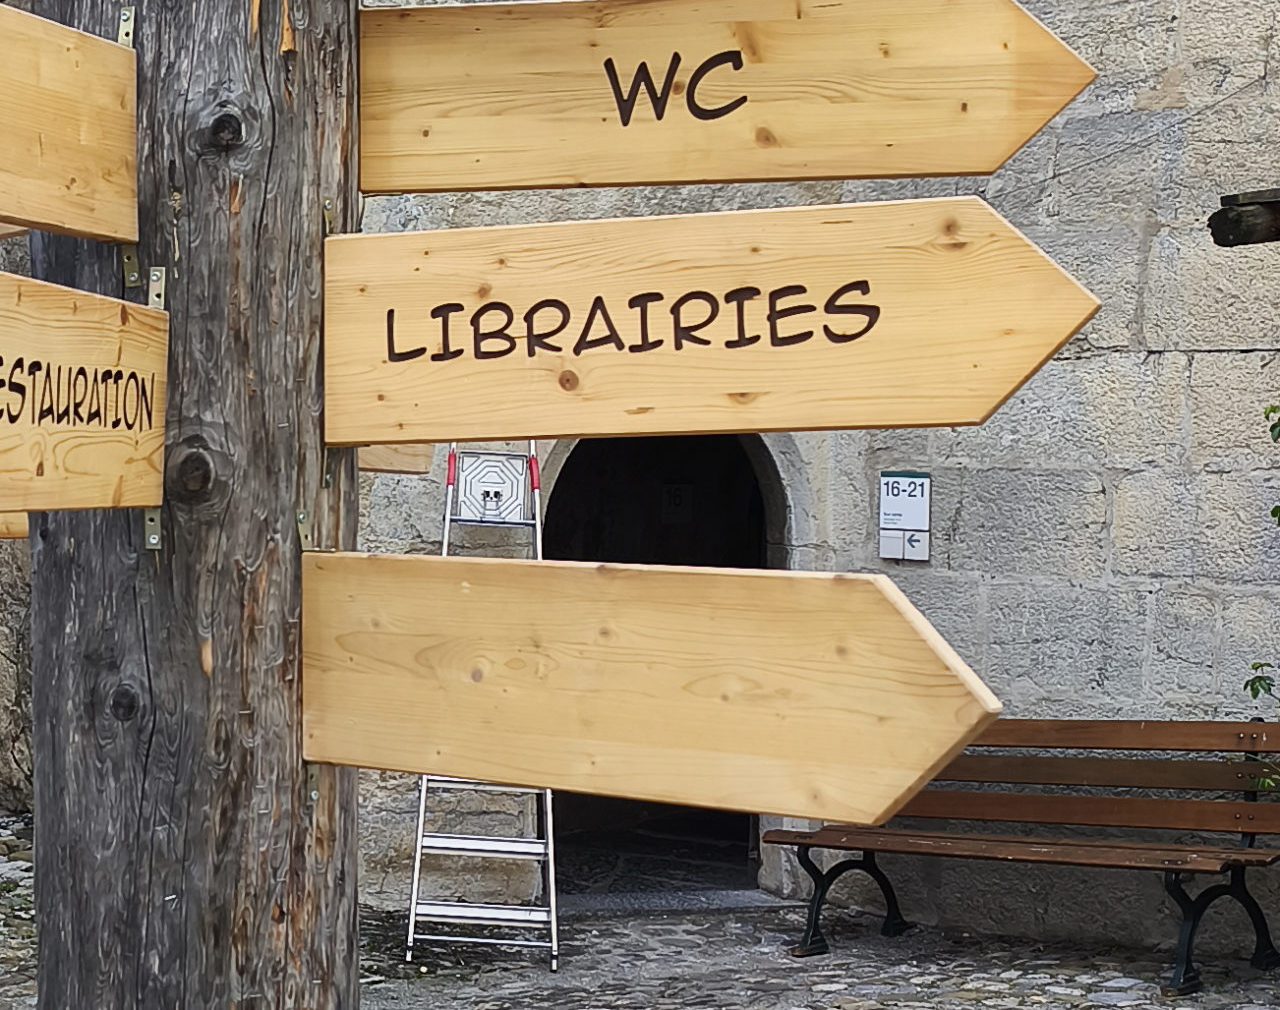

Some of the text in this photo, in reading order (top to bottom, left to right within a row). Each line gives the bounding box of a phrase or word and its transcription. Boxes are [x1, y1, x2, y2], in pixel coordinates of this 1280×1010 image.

[604, 50, 748, 127] WC
[386, 280, 881, 363] LIBRAIRIES
[883, 480, 925, 498] 16-21
